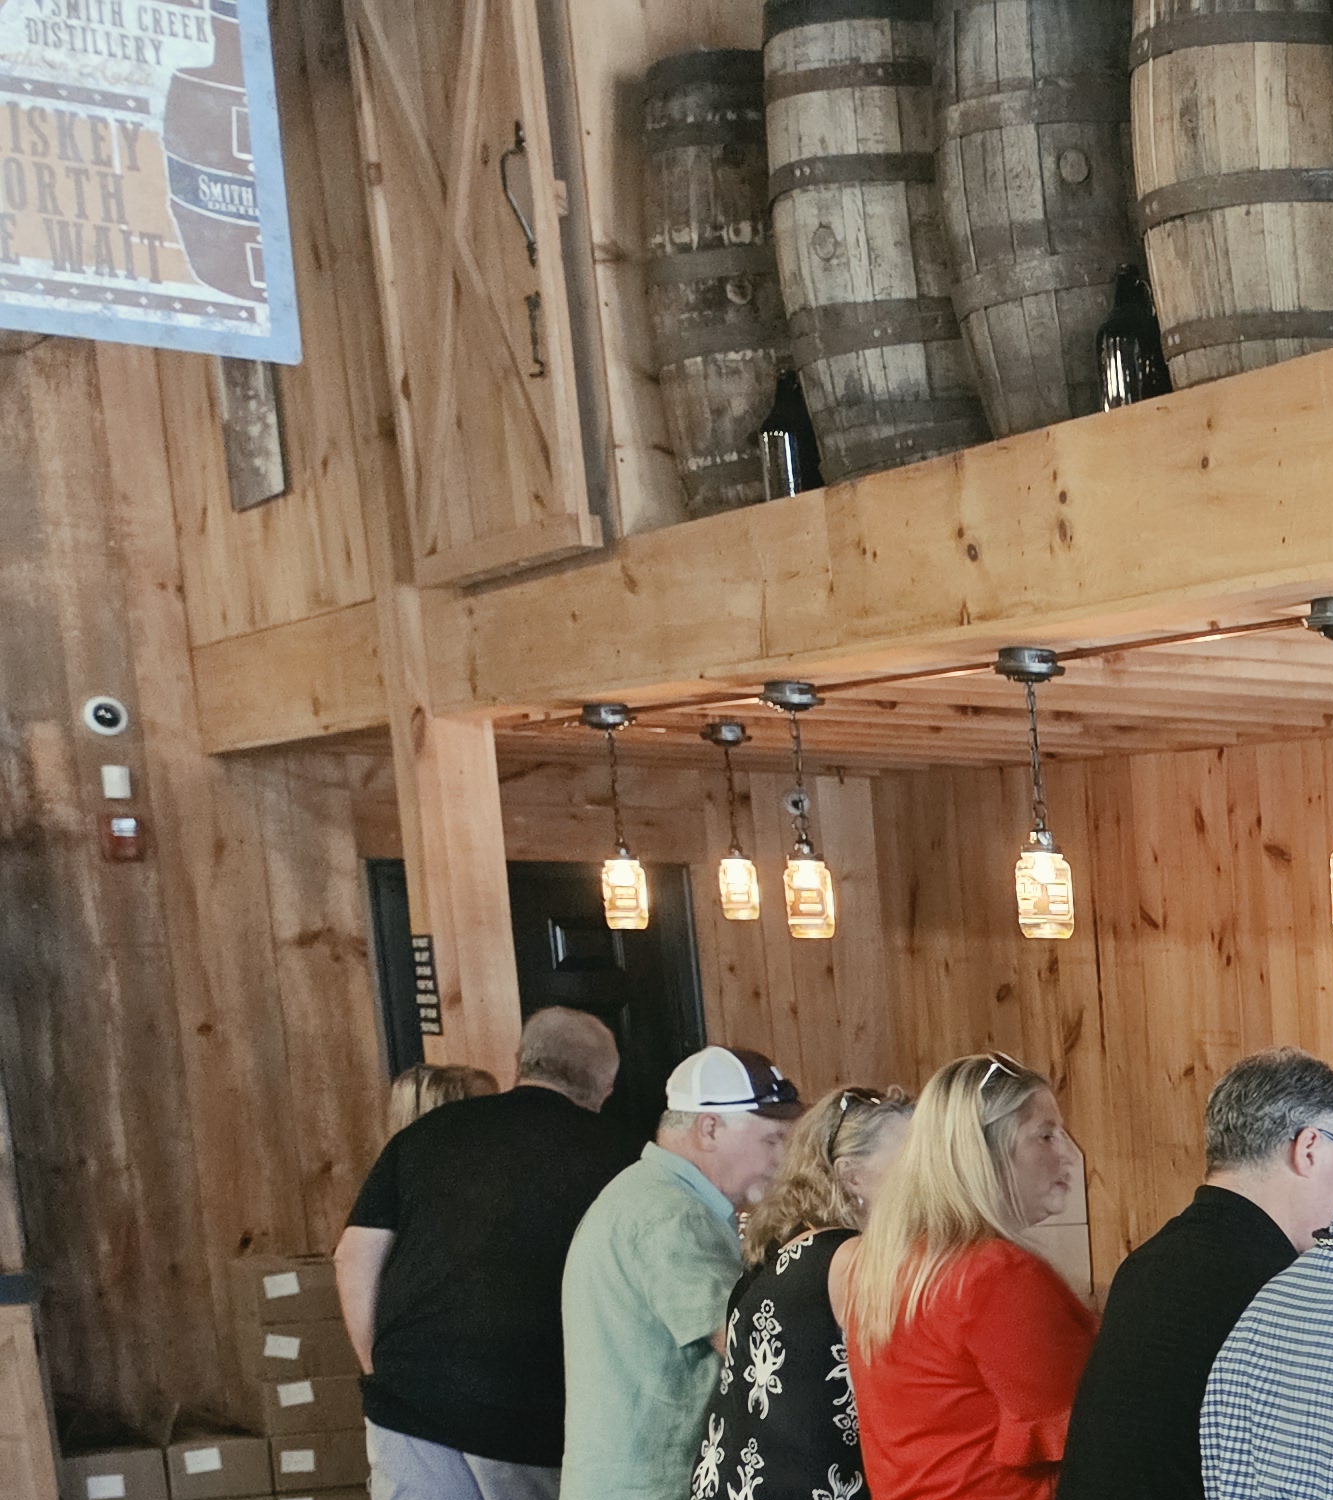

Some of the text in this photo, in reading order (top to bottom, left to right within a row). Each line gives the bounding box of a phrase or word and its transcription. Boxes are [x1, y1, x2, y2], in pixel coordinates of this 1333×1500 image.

[25, 17, 164, 66] DISTILLERY
[51, 0, 210, 43] SMITH CREEK
[198, 174, 254, 208] SMITH
[42, 217, 164, 285] WAIT
